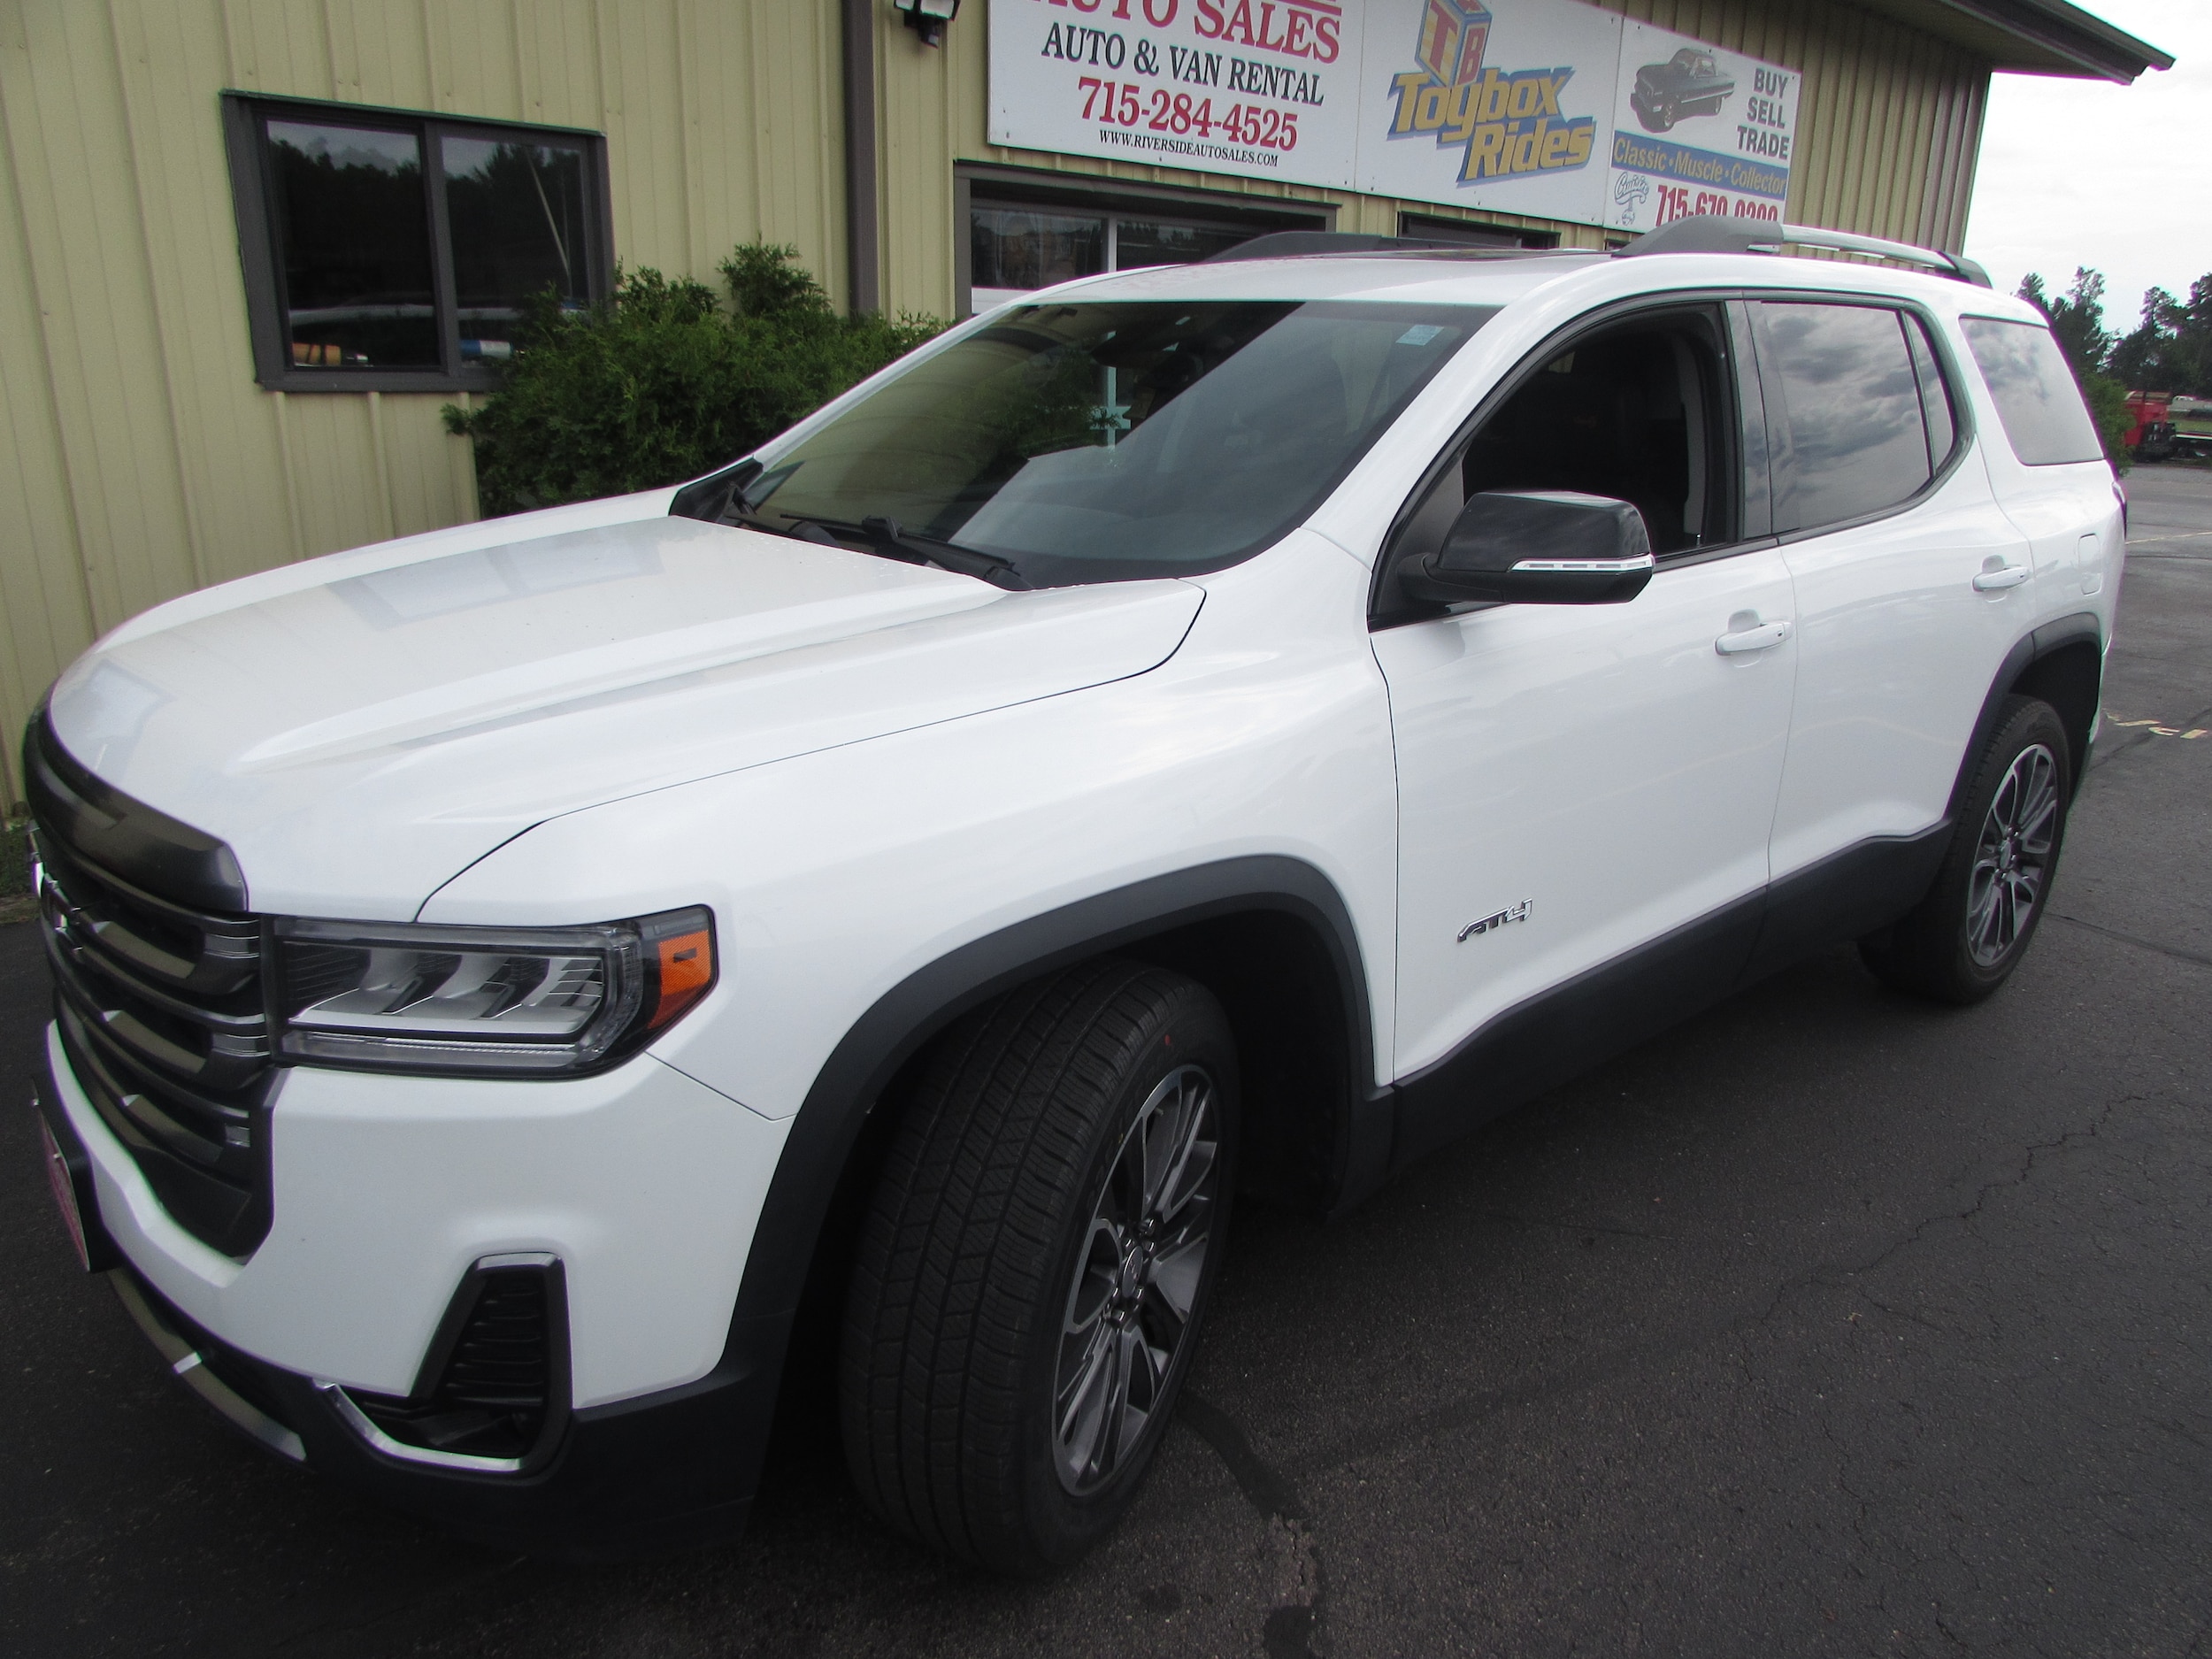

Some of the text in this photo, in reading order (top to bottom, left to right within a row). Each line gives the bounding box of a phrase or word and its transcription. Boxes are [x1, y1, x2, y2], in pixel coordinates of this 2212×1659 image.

[1194, 0, 1342, 64] SALES
[1041, 22, 1325, 106] AUTO & VAN RENTAL
[1753, 67, 1789, 99] BUY
[1078, 76, 1298, 151] 715-284-4525
[1394, 67, 1567, 143] Toybox
[1747, 96, 1786, 129] SELL
[1099, 129, 1279, 167] WWW.RIVERSIDEAUTOSALES.COM
[1463, 118, 1594, 181] Rides
[1613, 137, 1786, 196] Classic Muscle Collector
[1737, 125, 1790, 160] TRADE
[1457, 898, 1532, 942] AT4
